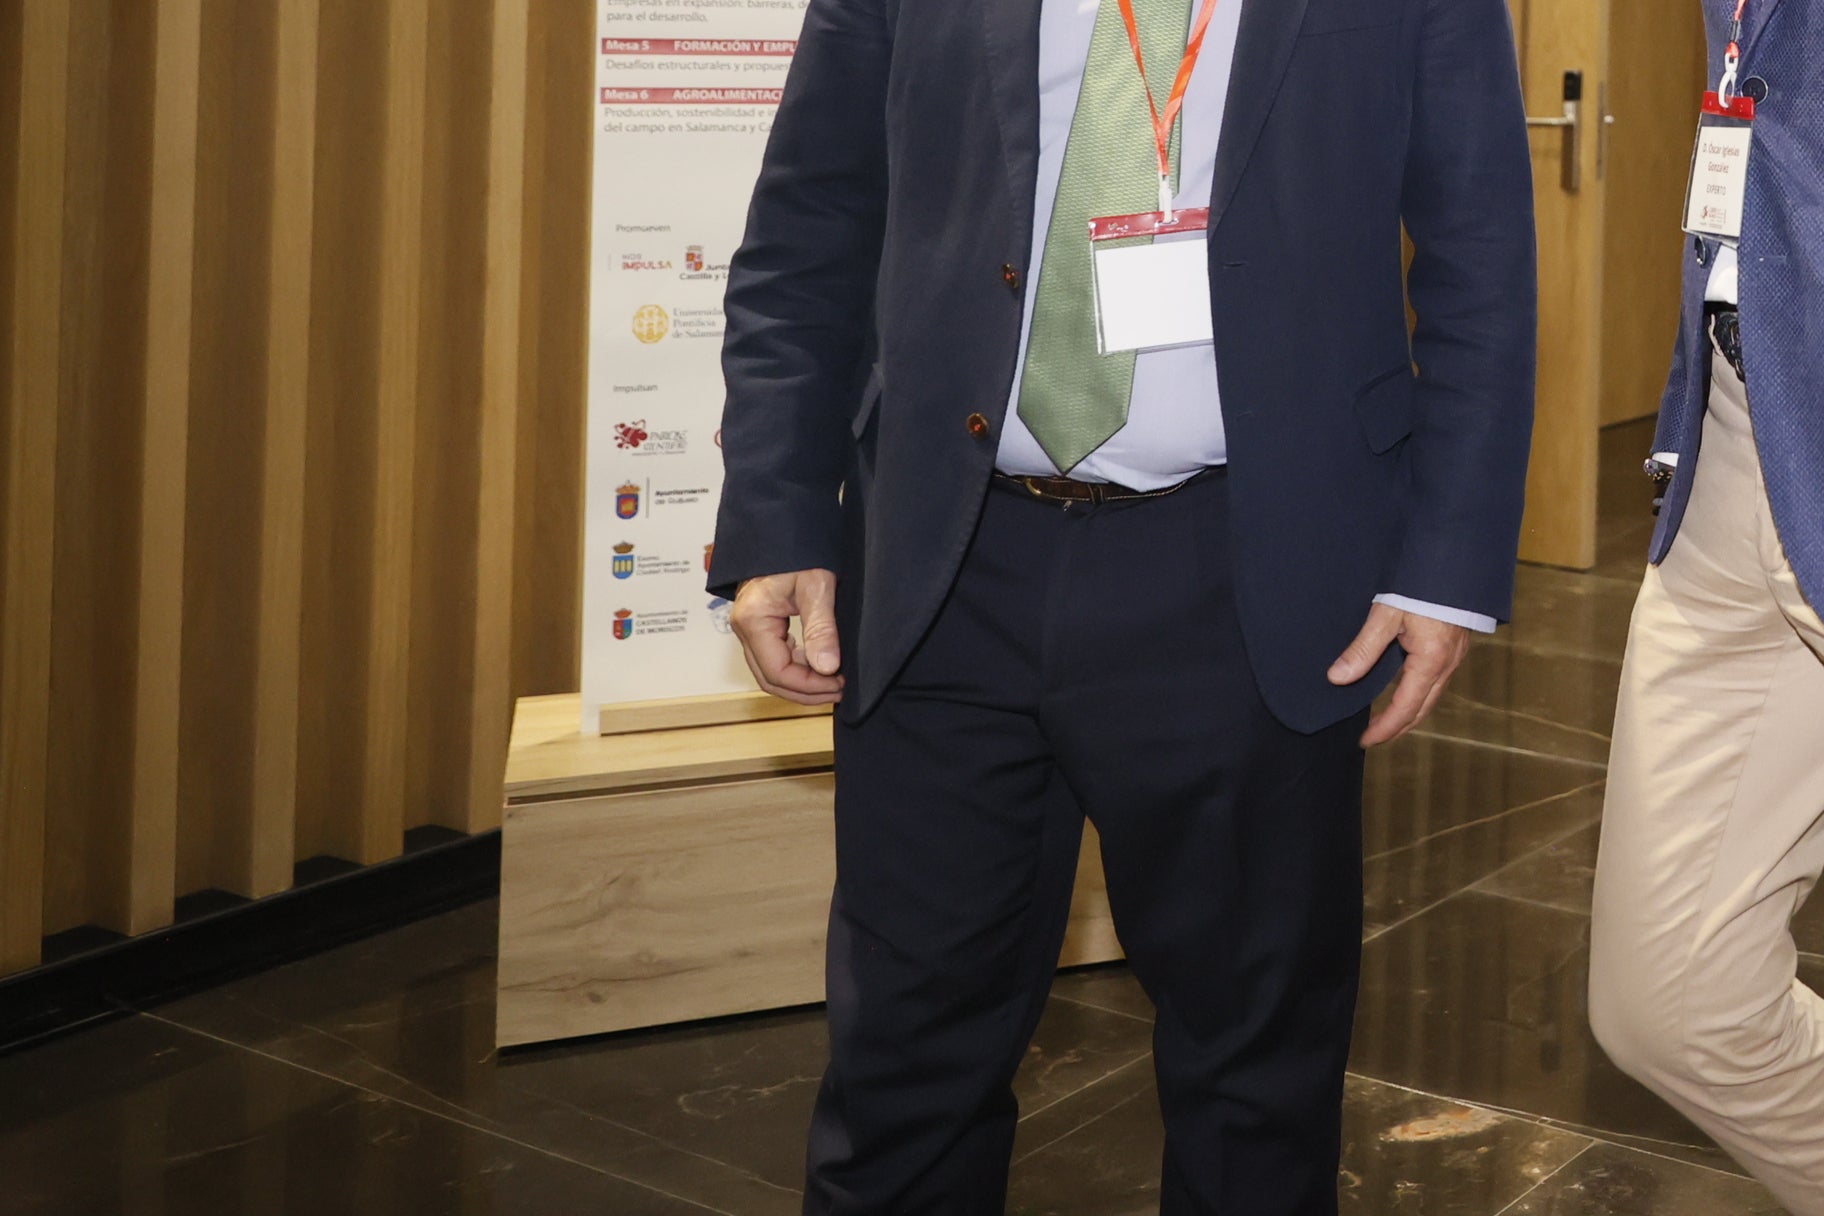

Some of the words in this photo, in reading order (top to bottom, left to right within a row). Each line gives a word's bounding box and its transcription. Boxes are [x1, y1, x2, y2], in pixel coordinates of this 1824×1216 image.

[607, 12, 633, 22] para
[635, 12, 645, 21] el
[606, 40, 640, 50] Mesa
[641, 40, 650, 50] 5
[674, 40, 750, 52] FORMACIÓN
[753, 43, 761, 52] Y
[606, 59, 654, 70] Desafíos
[658, 62, 731, 71] estructurales
[734, 64, 740, 72] y
[604, 89, 638, 99] Mesa
[640, 89, 649, 99] 6
[676, 108, 755, 118] sostenibilidad
[603, 122, 623, 132] del
[625, 124, 665, 134] campo
[686, 123, 747, 132] Salamanca
[750, 125, 756, 134] y
[622, 261, 672, 272] IMPULSA
